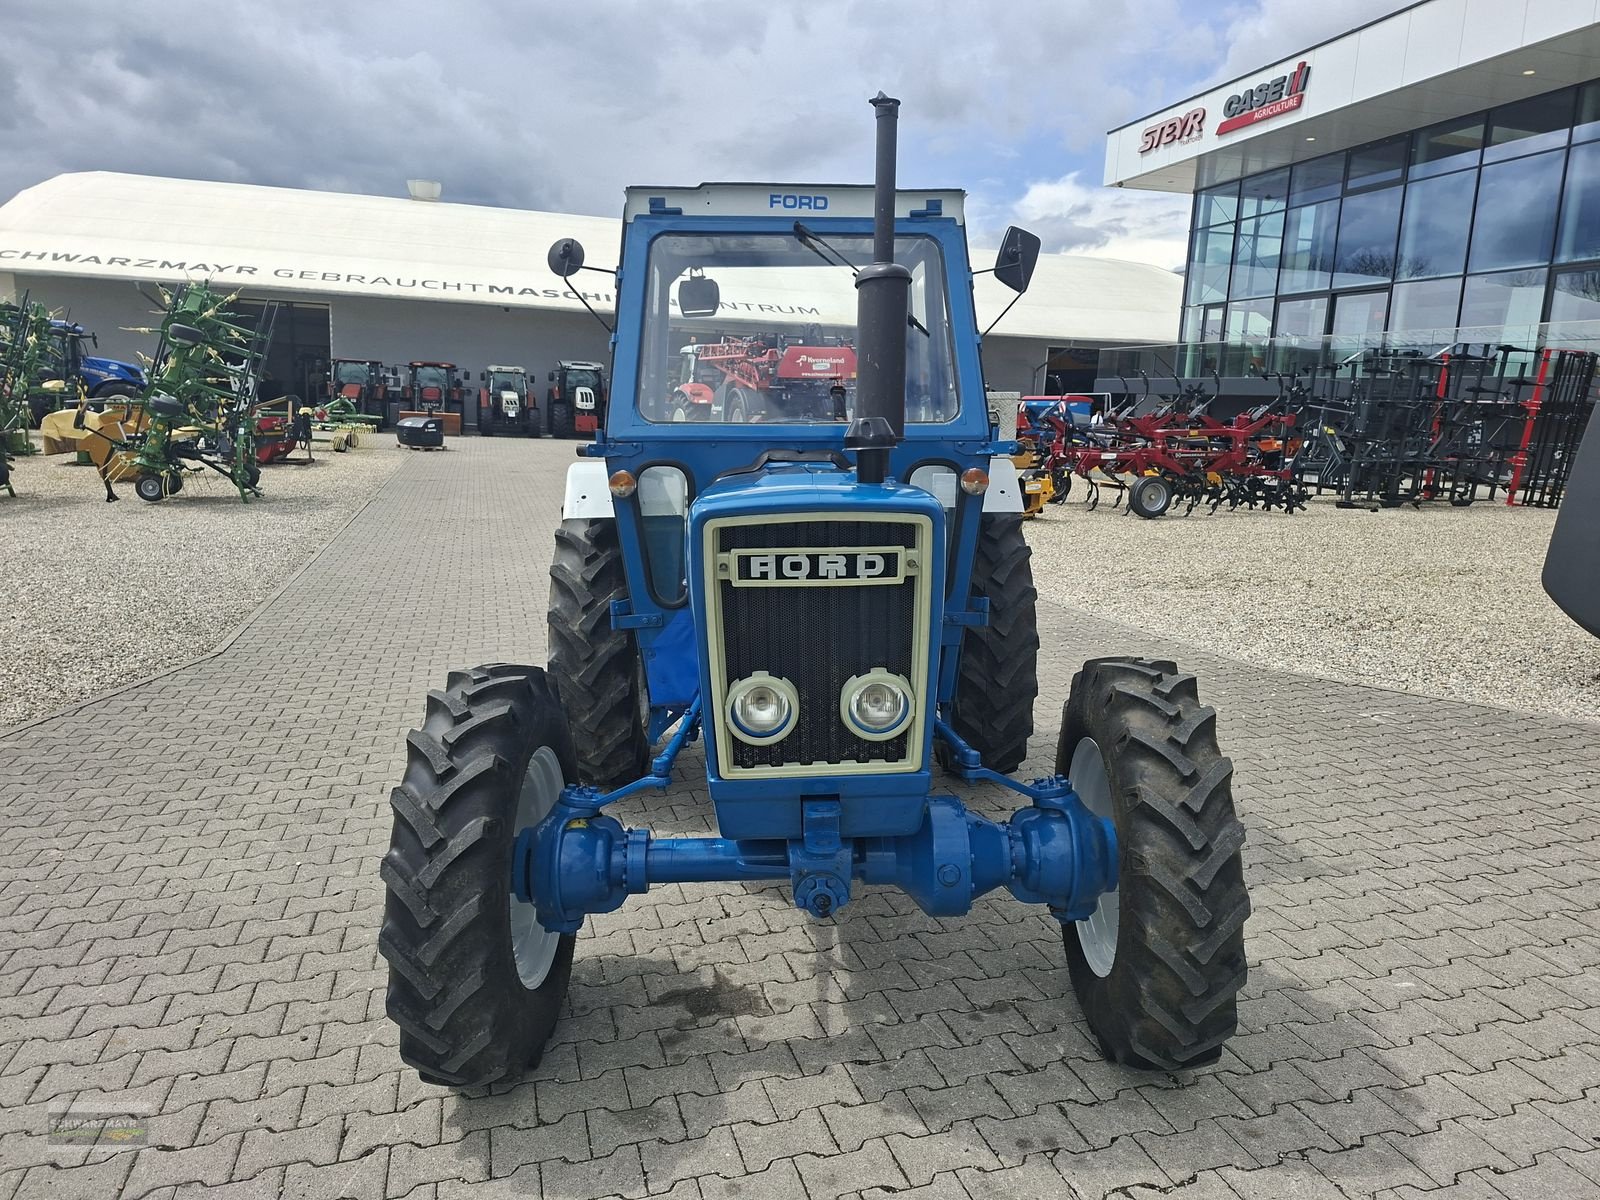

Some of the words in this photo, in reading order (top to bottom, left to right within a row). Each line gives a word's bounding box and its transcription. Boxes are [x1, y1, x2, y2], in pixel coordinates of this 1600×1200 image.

[1223, 76, 1287, 118] CASE
[1253, 97, 1298, 120] AGRICULTURE
[1138, 107, 1206, 153] STEYR
[769, 194, 829, 211] FORD
[807, 356, 844, 364] Kverneland
[750, 554, 885, 580] FORD
